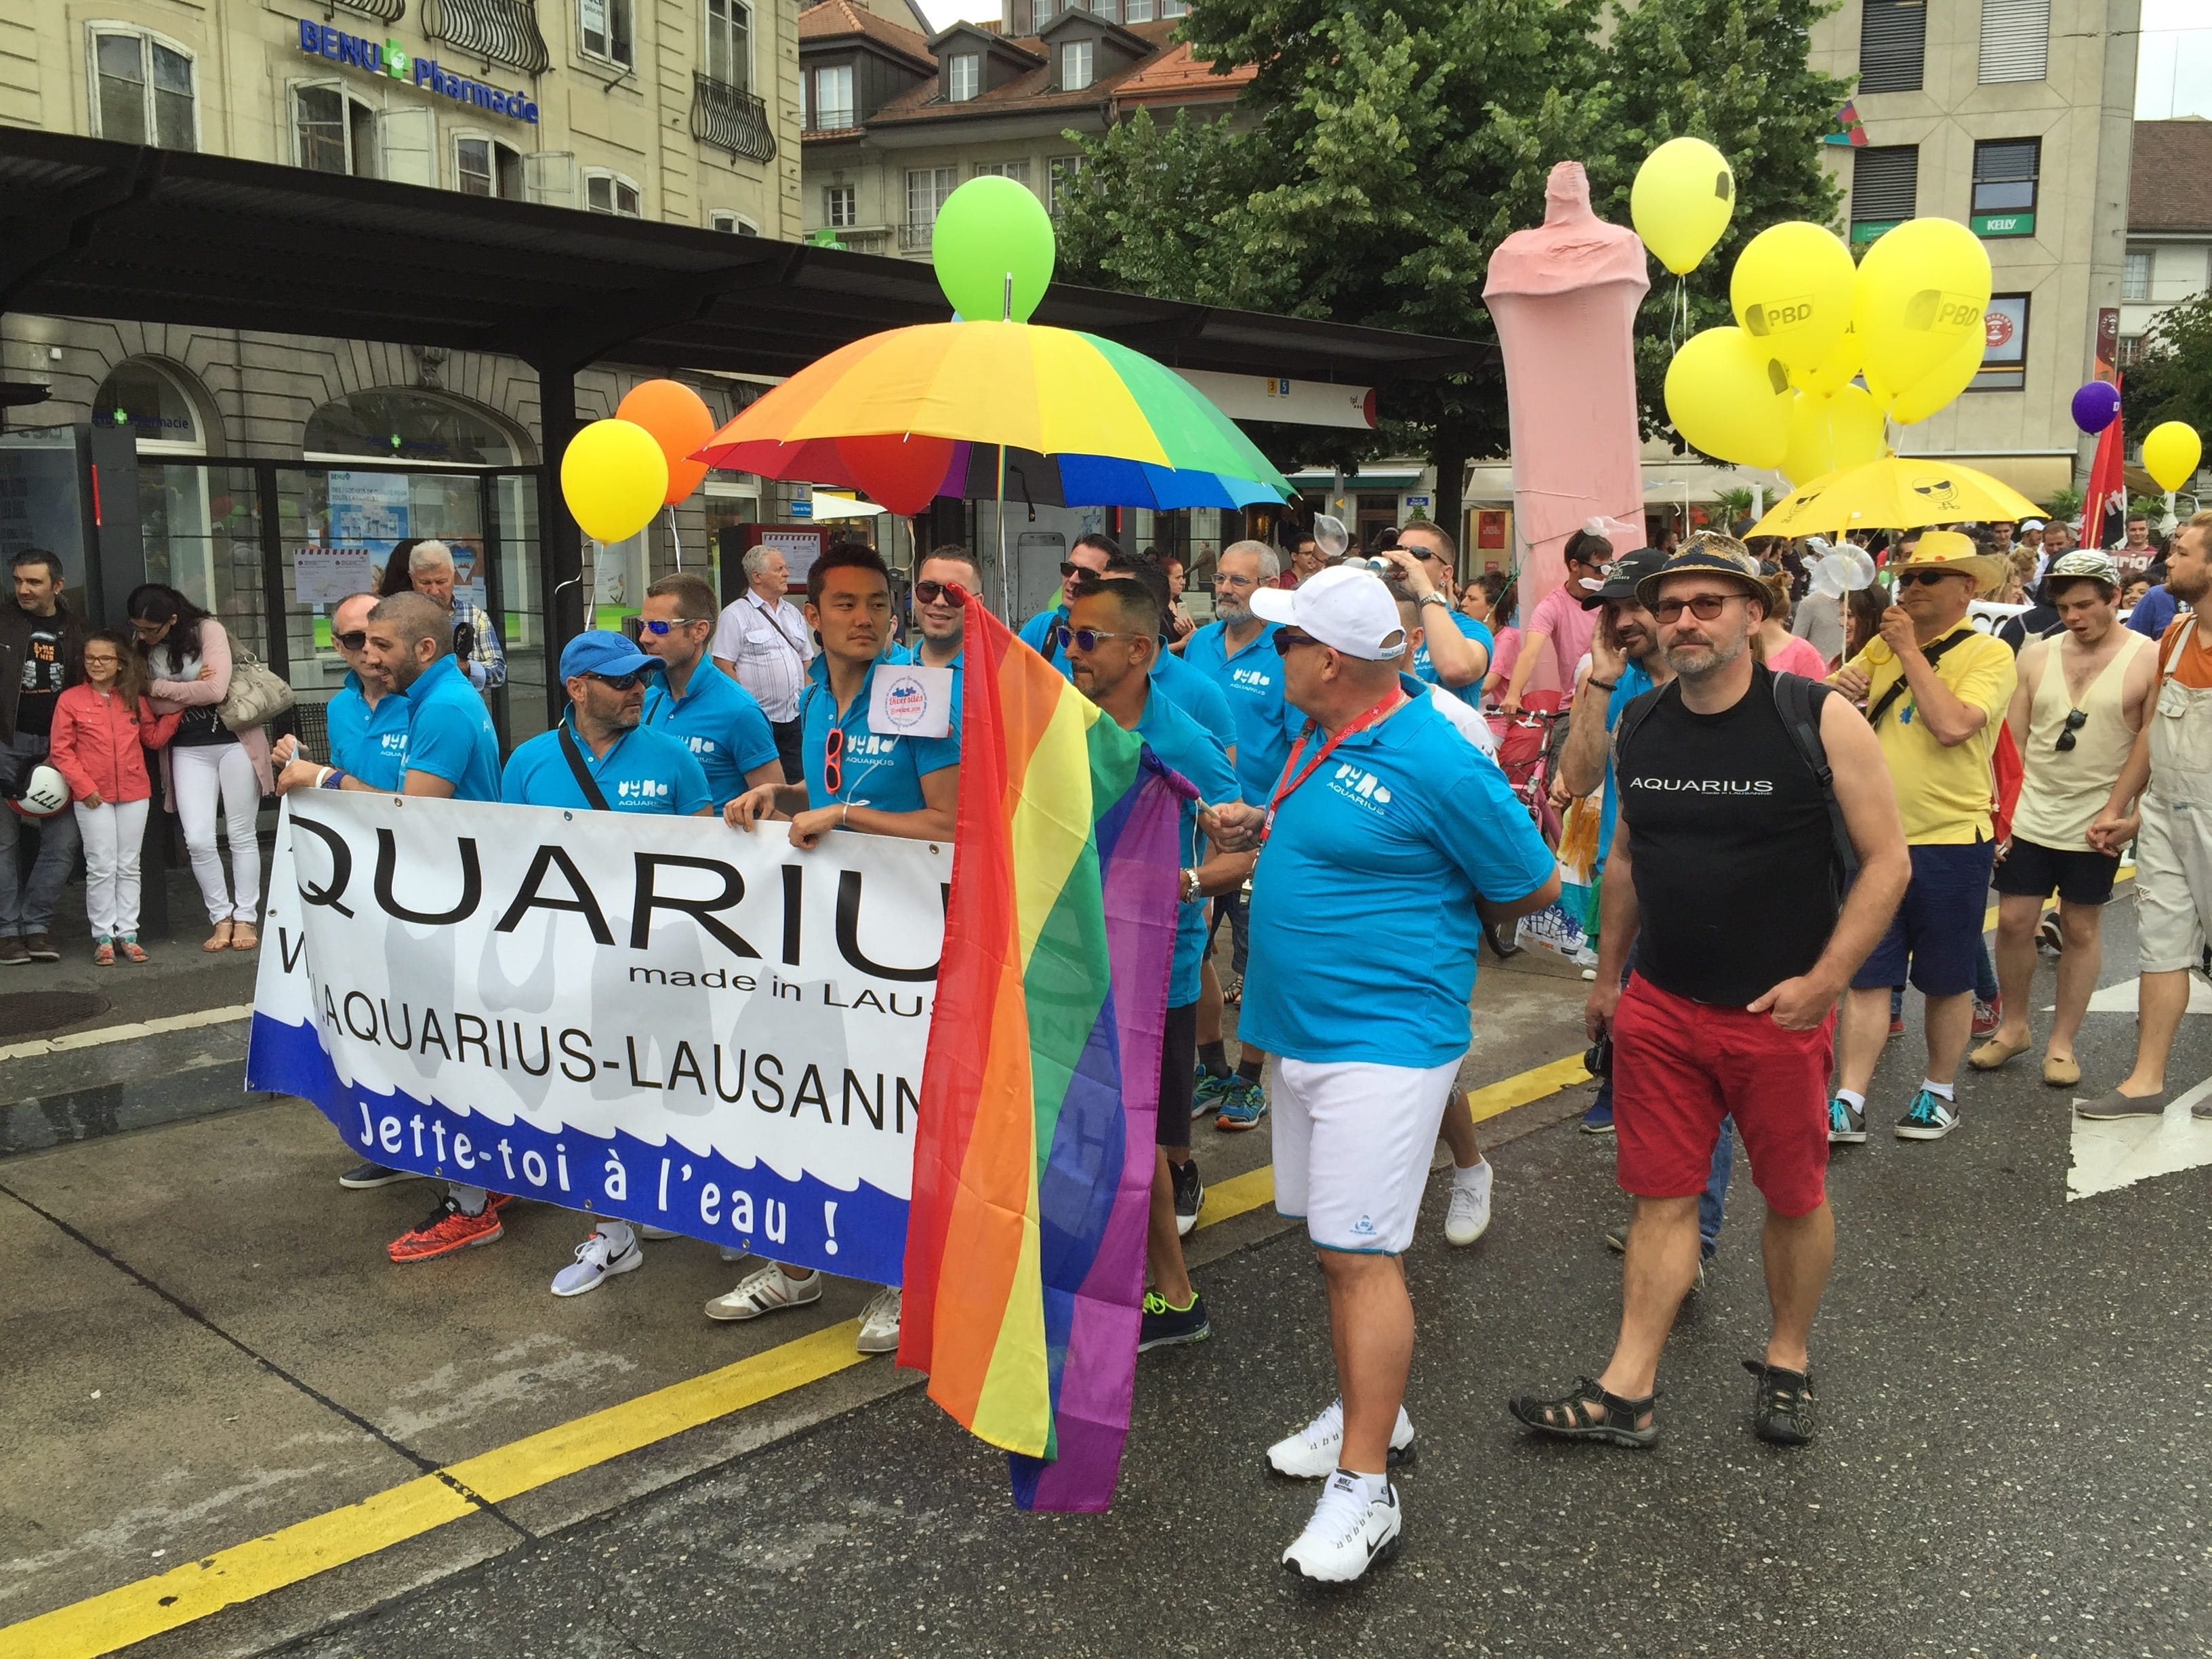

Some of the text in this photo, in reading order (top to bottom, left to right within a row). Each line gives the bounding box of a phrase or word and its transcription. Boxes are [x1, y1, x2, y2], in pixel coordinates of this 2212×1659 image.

[298, 18, 539, 124] BENU Pharmacie
[1987, 219, 2017, 230] KELLY
[1768, 303, 1812, 327] PBD
[1938, 303, 1980, 327] PBD
[1269, 381, 1275, 391] 3
[1282, 381, 1287, 392] 5
[1229, 683, 1266, 696] AQUARIUS
[846, 756, 895, 766] AQUARIUS
[1629, 777, 1774, 792] AQUARIUS
[1326, 781, 1385, 816] AQUARIUS
[629, 966, 757, 991] made
[772, 975, 802, 1002] in
[359, 1101, 838, 1256] Jette-toi à l'eau !
[1337, 1477, 1352, 1487] NIKE
